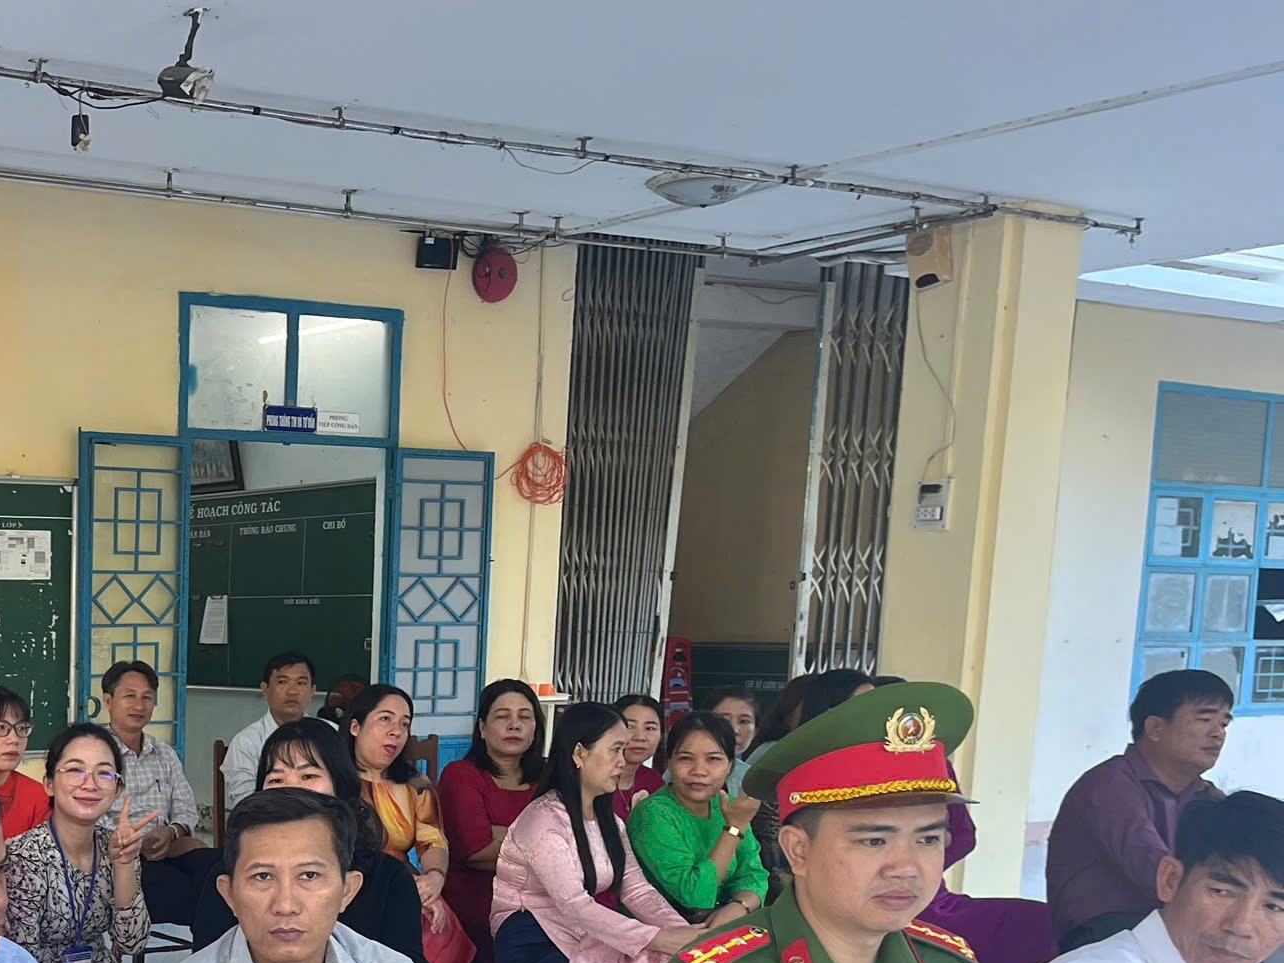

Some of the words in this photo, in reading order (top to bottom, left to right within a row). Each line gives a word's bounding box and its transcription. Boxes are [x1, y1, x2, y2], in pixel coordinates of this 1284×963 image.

[196, 505, 230, 519] HOẠCH
[231, 501, 257, 516] CÔNG
[260, 497, 281, 513] TÁC
